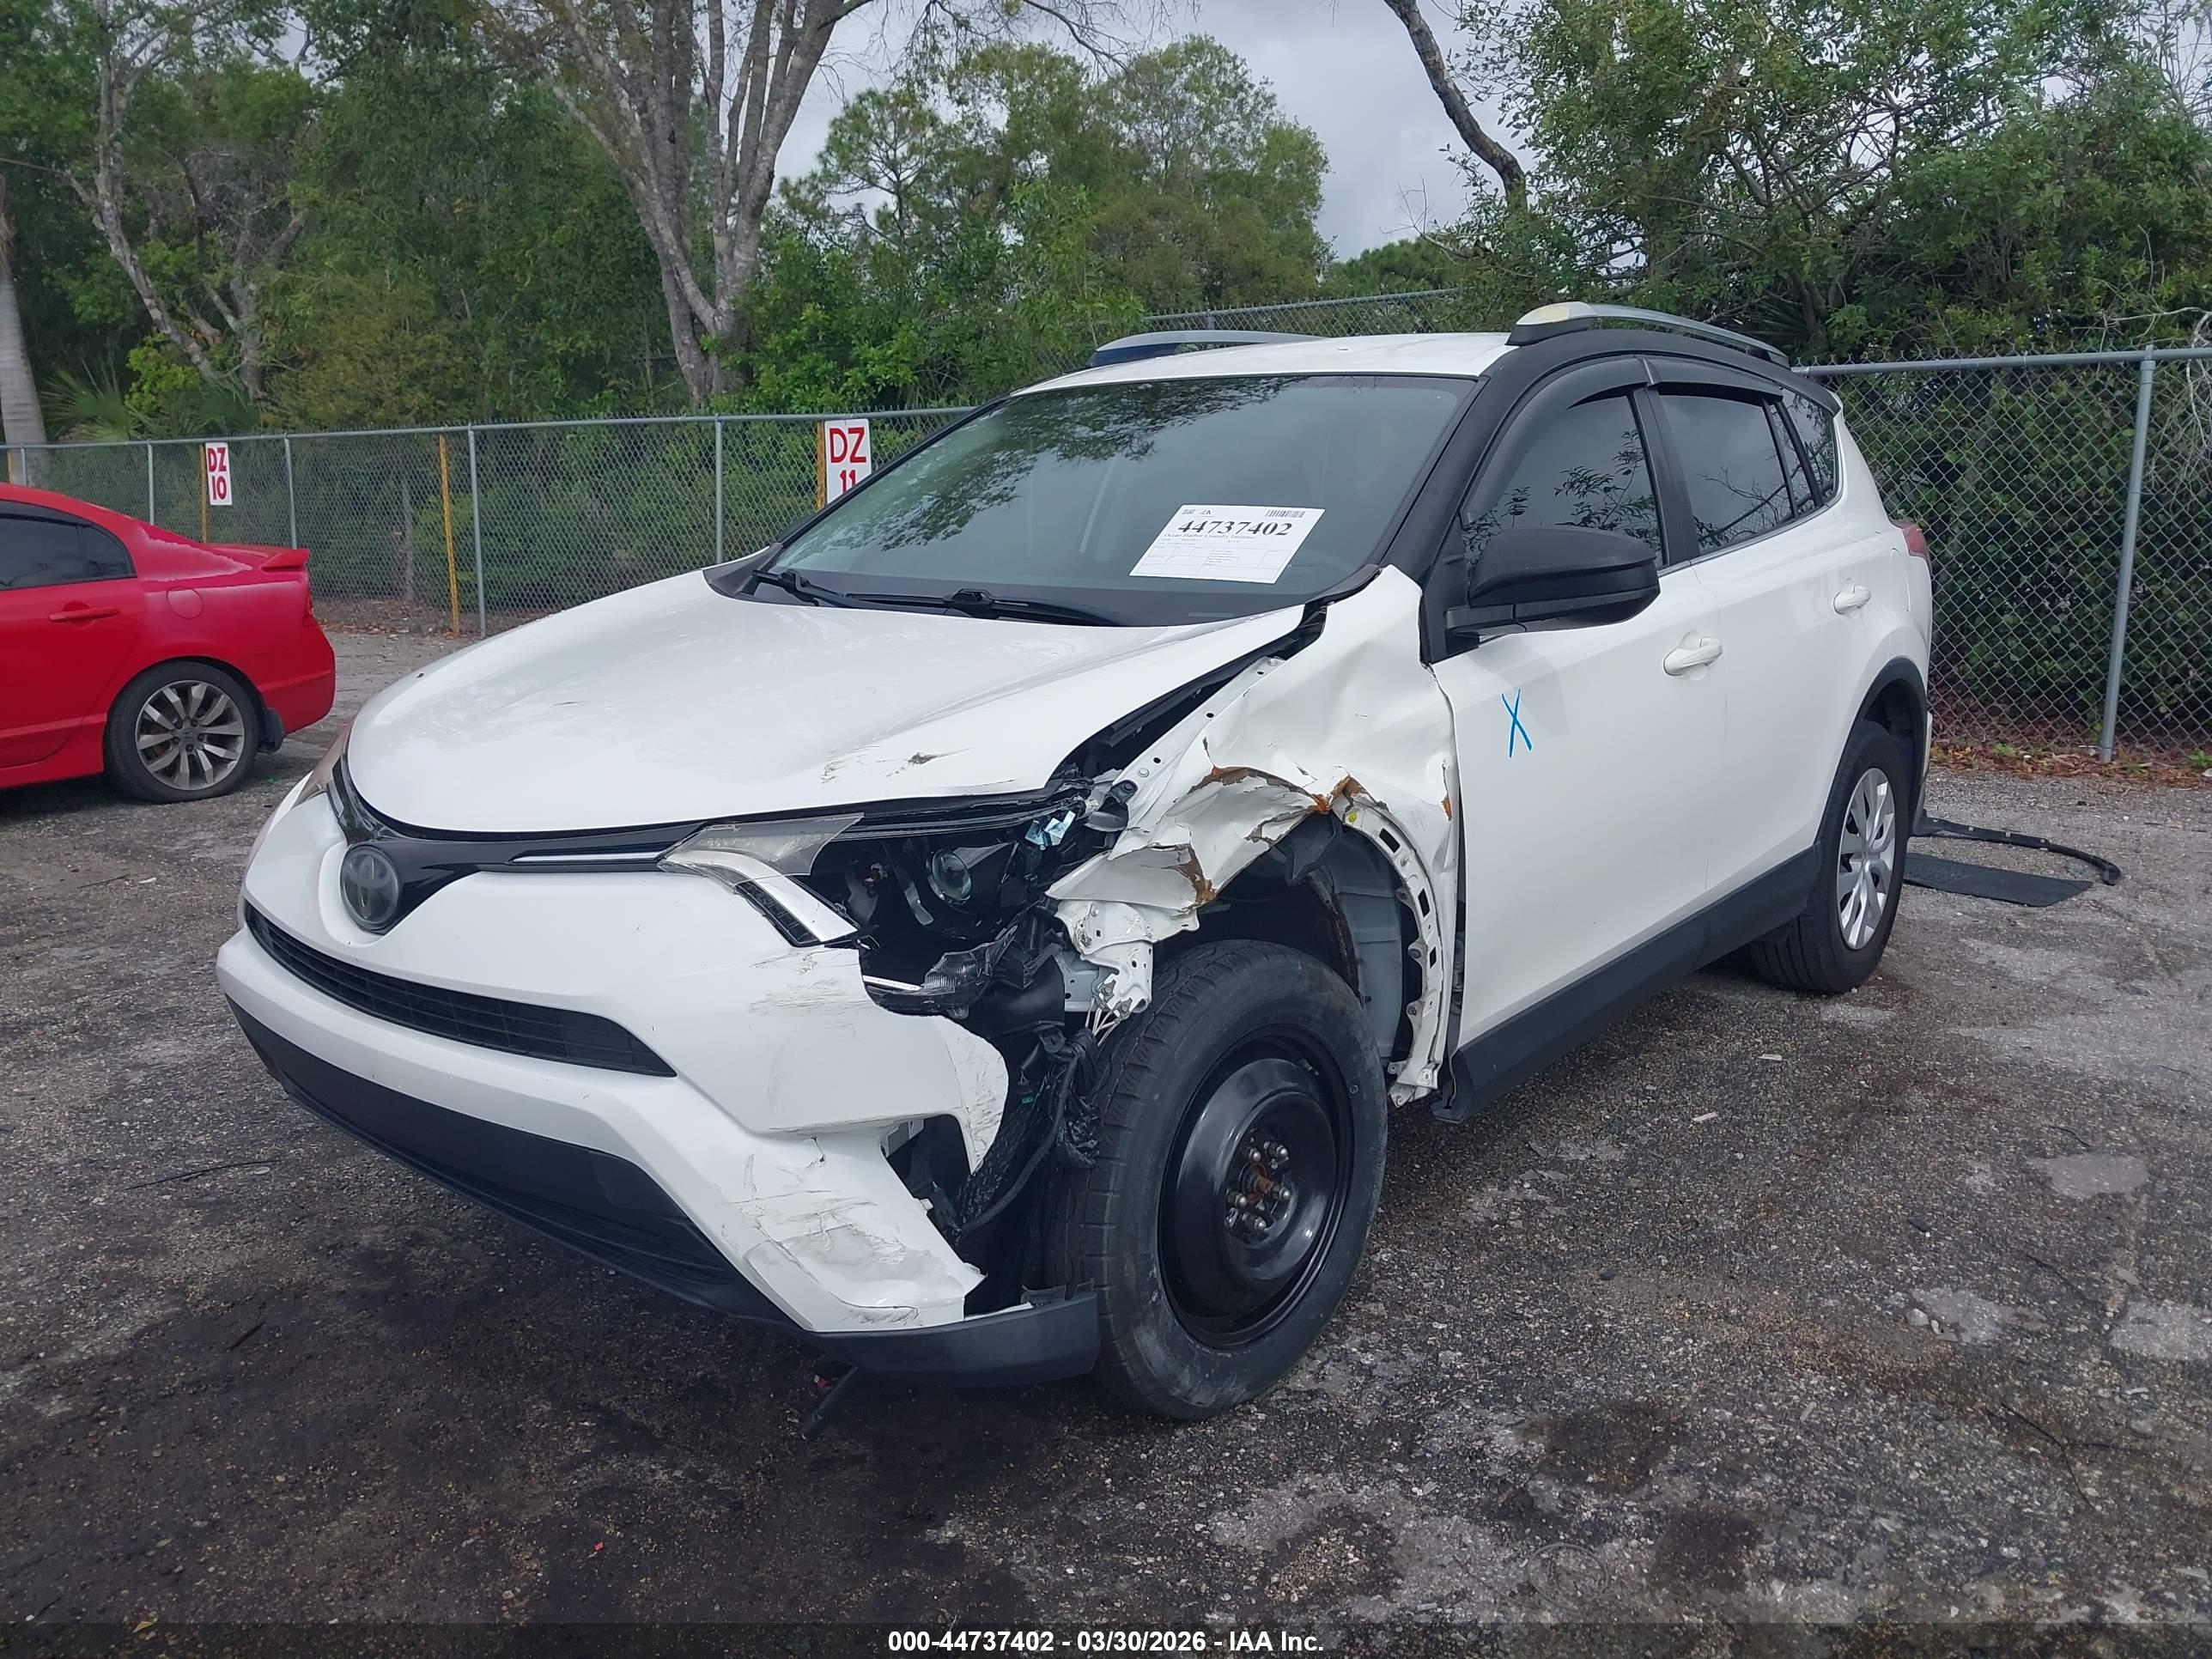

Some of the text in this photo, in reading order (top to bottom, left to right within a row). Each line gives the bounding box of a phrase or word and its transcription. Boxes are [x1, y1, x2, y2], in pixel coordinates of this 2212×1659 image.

[829, 427, 866, 463] DZ
[208, 447, 227, 471] DZ
[212, 476, 227, 500] 10
[840, 470, 856, 495] 11
[1178, 520, 1292, 536] 44737402
